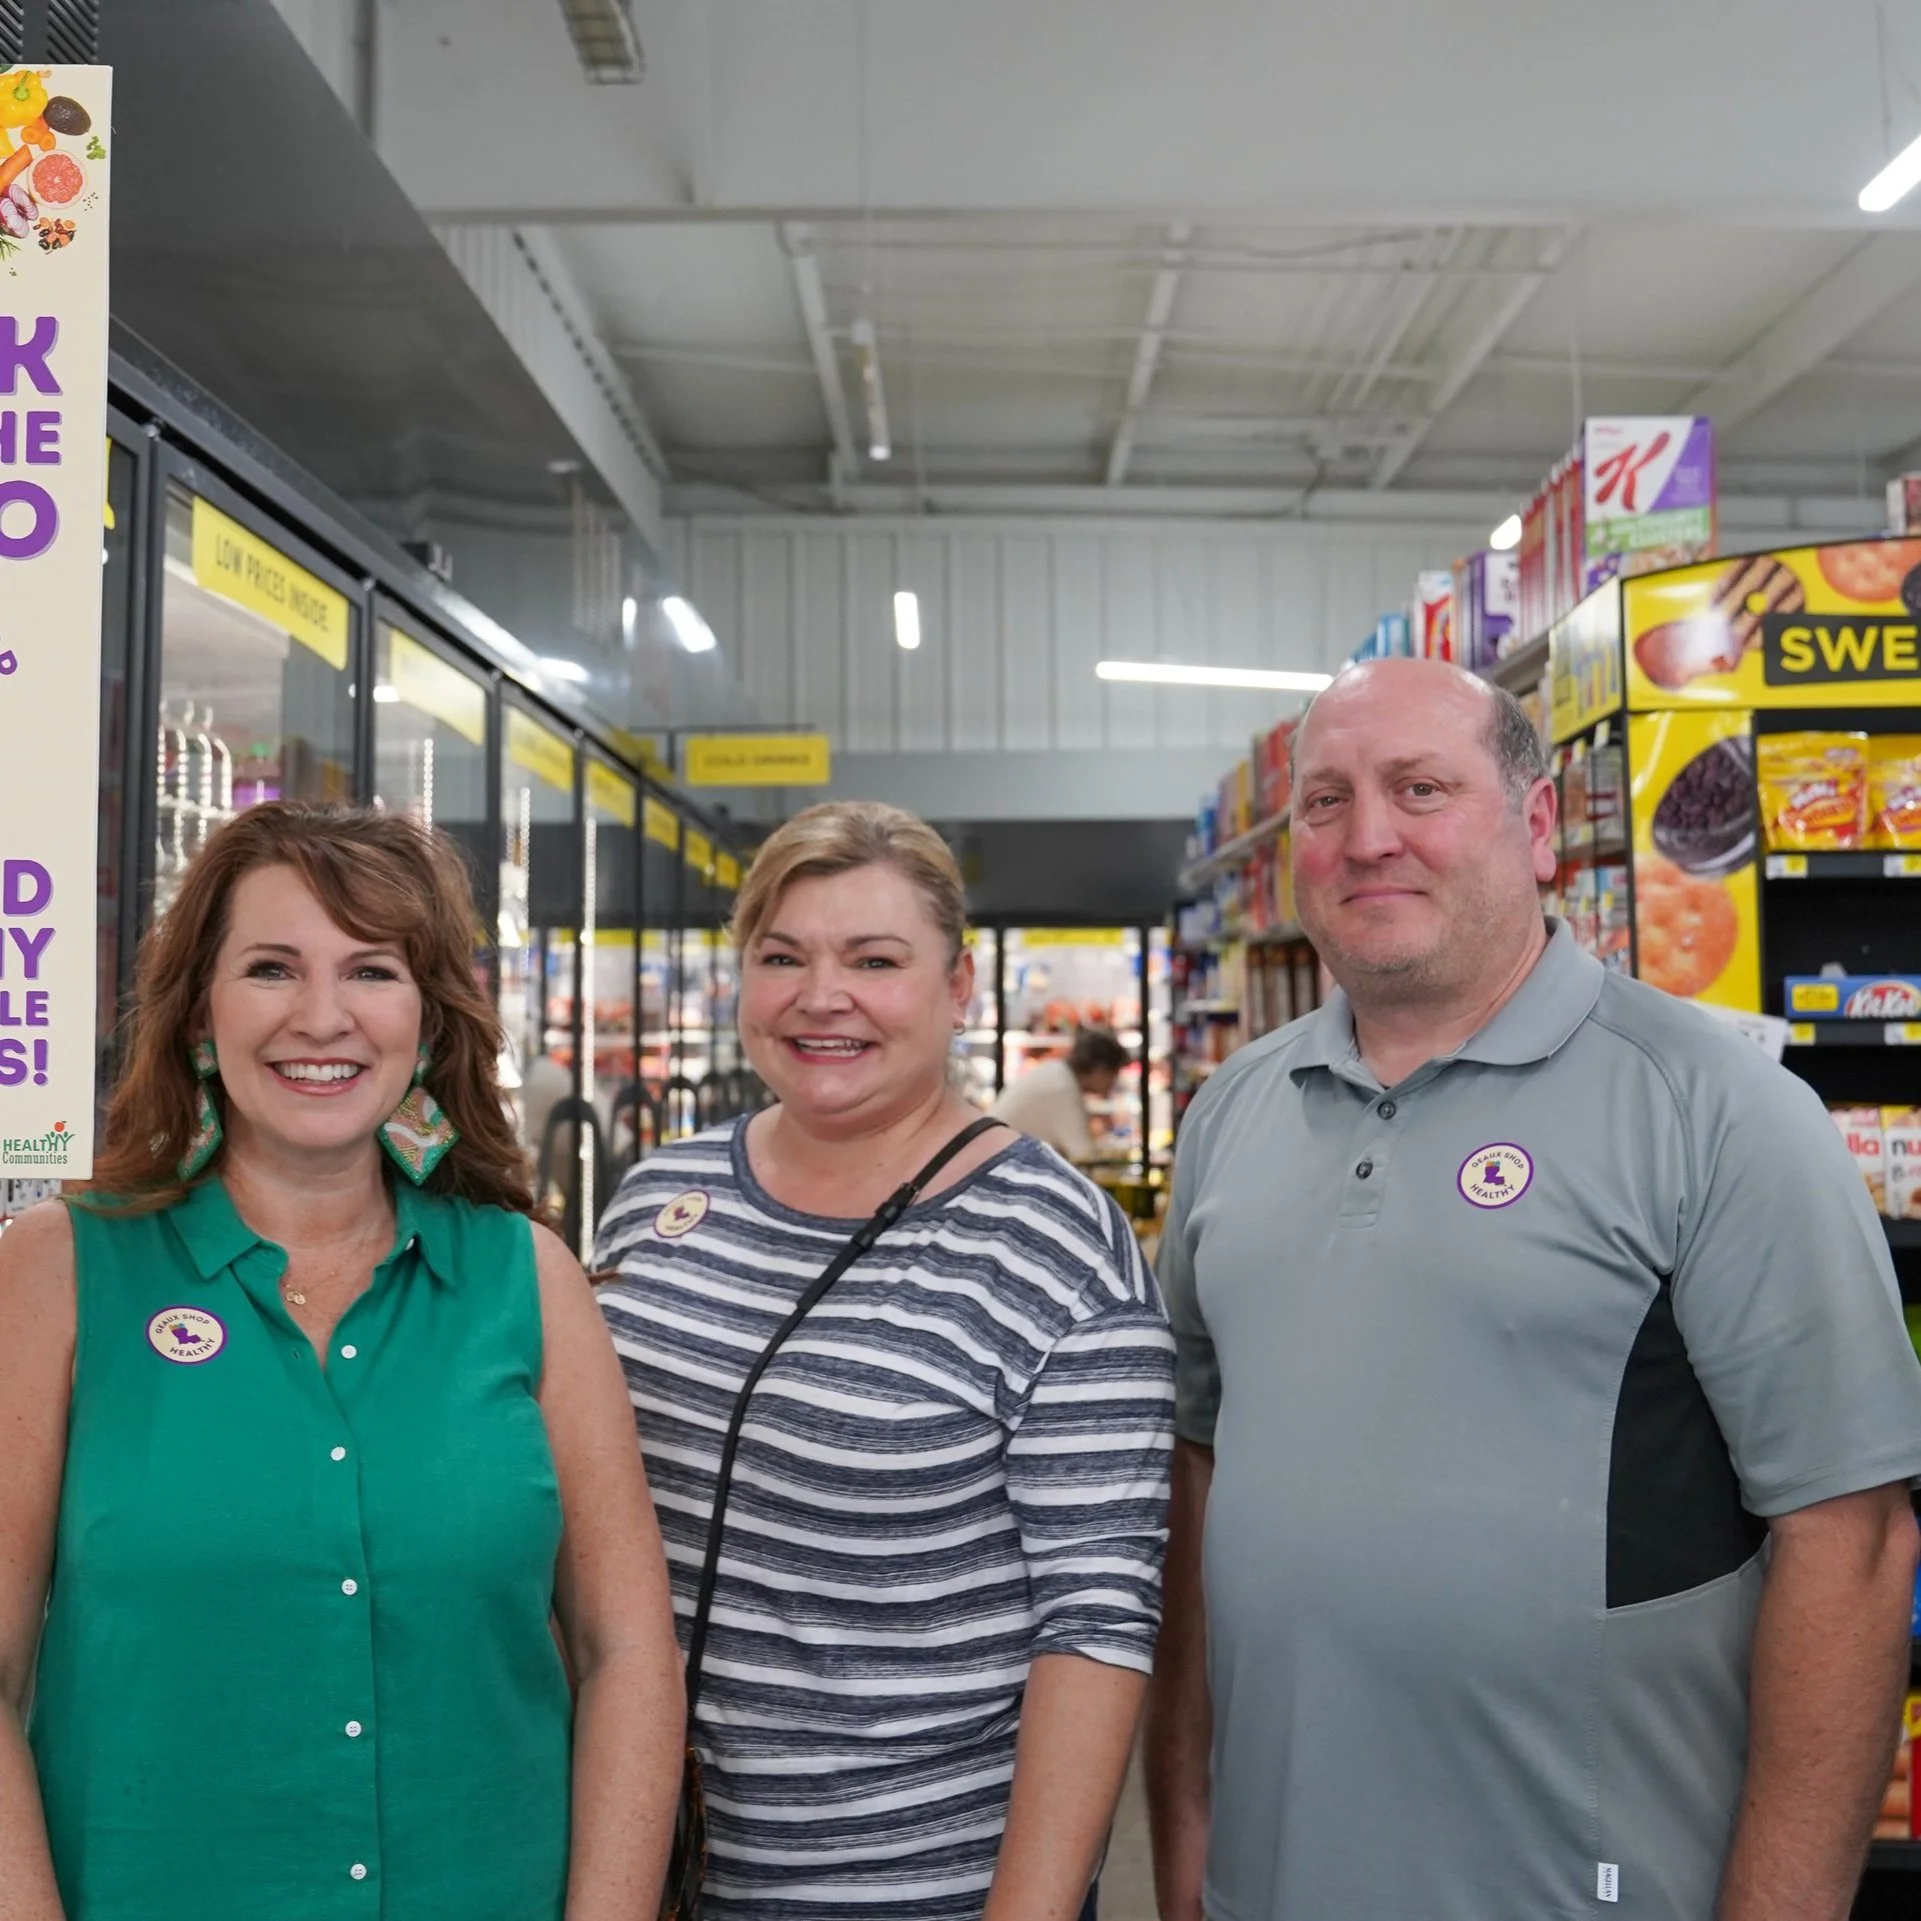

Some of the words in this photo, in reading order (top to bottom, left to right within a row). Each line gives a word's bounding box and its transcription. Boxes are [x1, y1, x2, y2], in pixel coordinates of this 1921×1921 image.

[215, 532, 243, 578] LOW
[247, 553, 286, 605] PRICES
[1780, 625, 1919, 673] SWE
[3, 859, 54, 917] D
[0, 928, 56, 980] Y
[3, 1133, 76, 1151] HEALTHY
[2, 1151, 68, 1165] Communities
[1503, 1152, 1524, 1169] SHOP
[1469, 1183, 1515, 1199] HEALTHY
[182, 1313, 210, 1325] SHOP
[169, 1337, 215, 1357] HEALTHY
